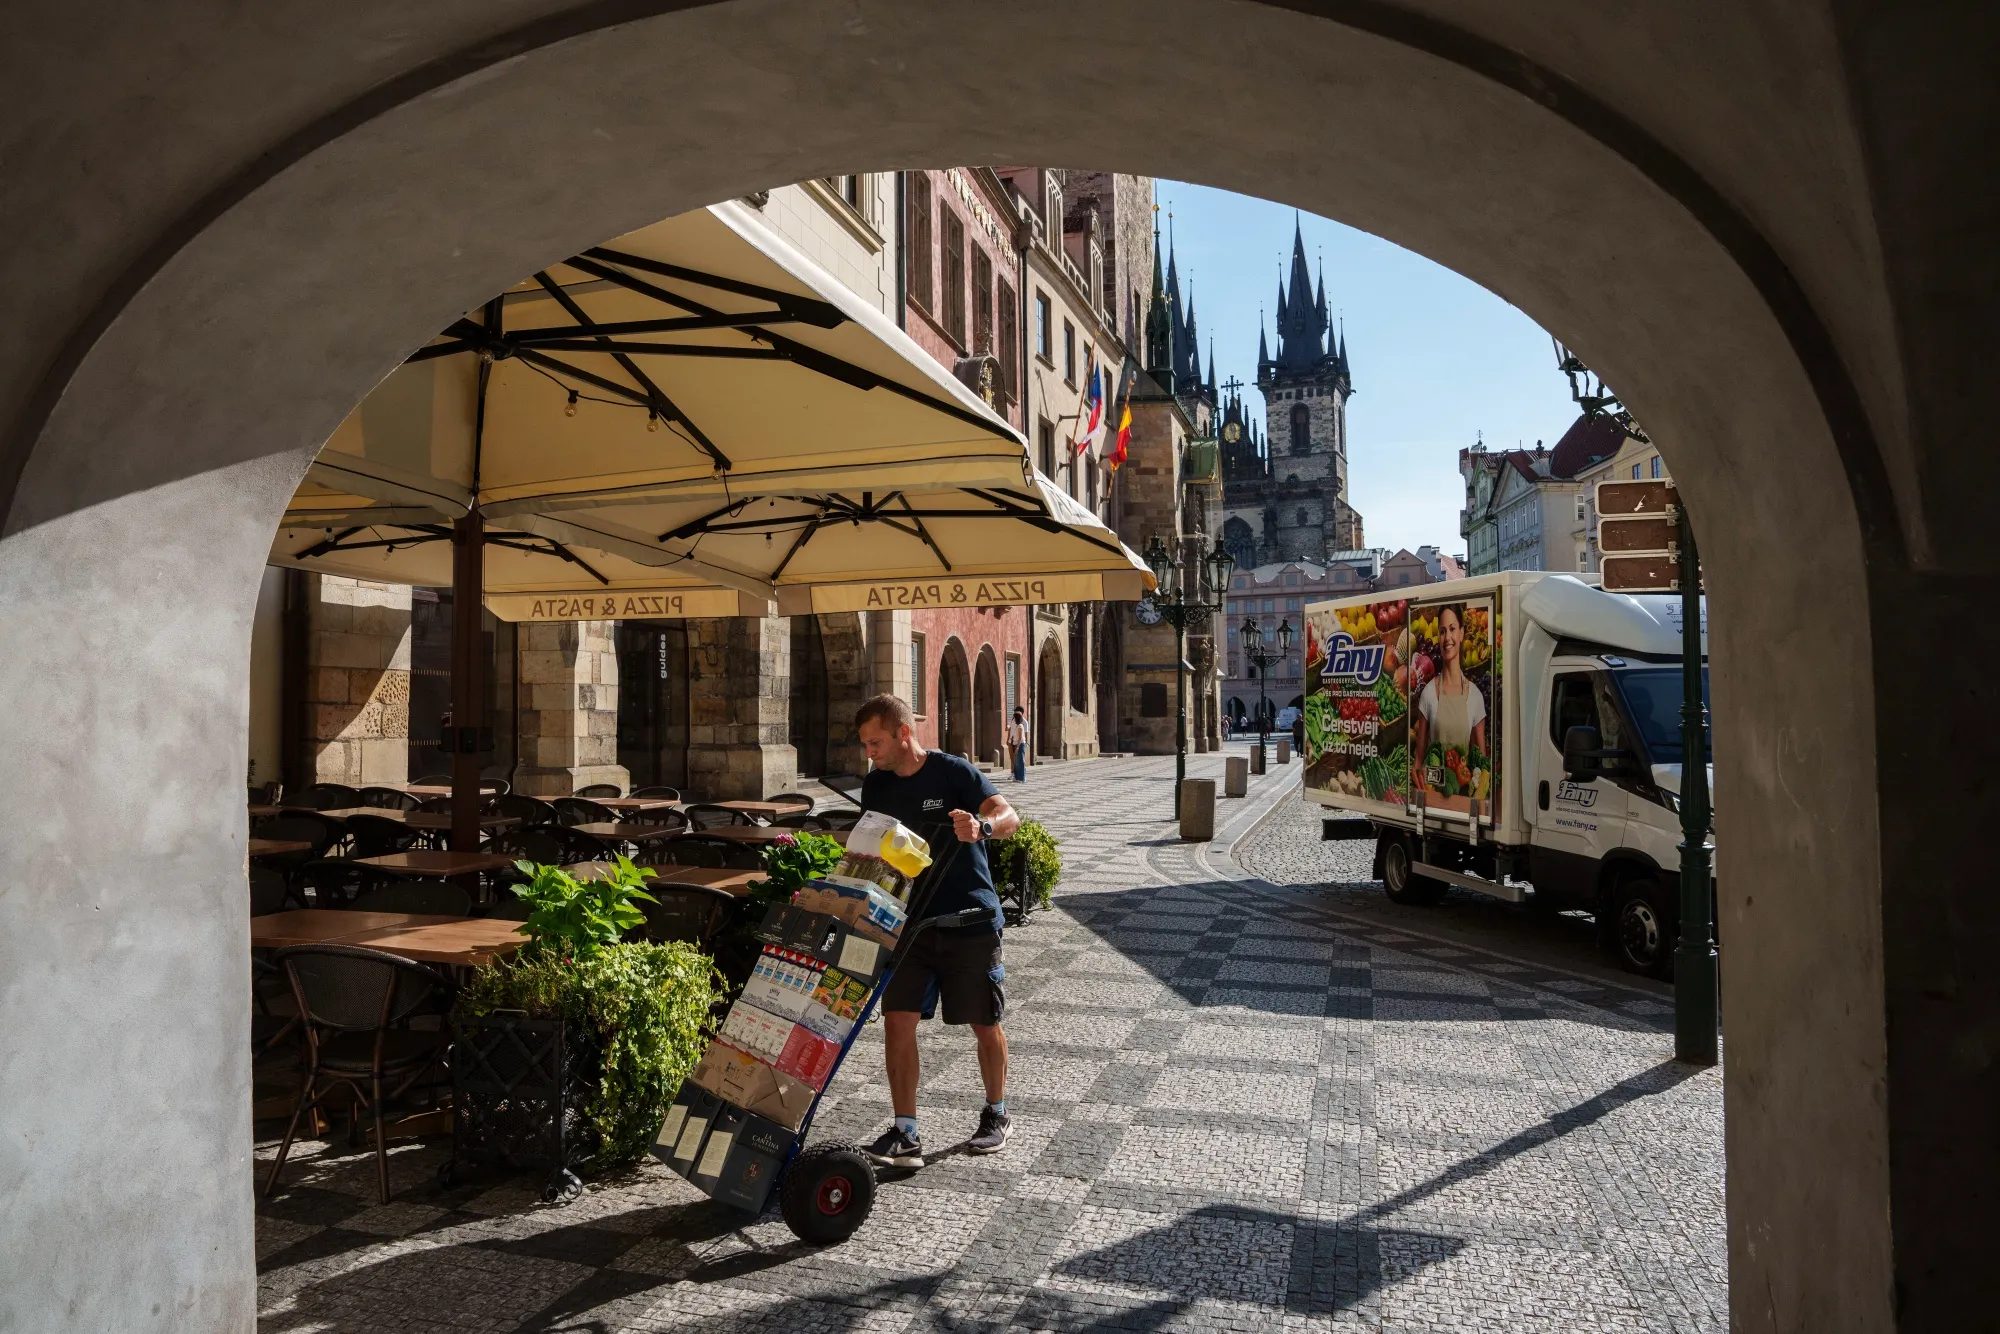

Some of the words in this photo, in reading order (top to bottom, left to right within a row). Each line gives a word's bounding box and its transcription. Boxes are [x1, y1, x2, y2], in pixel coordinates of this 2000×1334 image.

[659, 633, 668, 679] guides
[1322, 709, 1379, 740] Čerstvěji
[1335, 742, 1347, 755] to
[1348, 740, 1378, 760] nejde
[1555, 818, 1597, 831] www.fany.cz
[752, 1134, 779, 1150] CANTINA
[765, 1133, 772, 1141] LA
